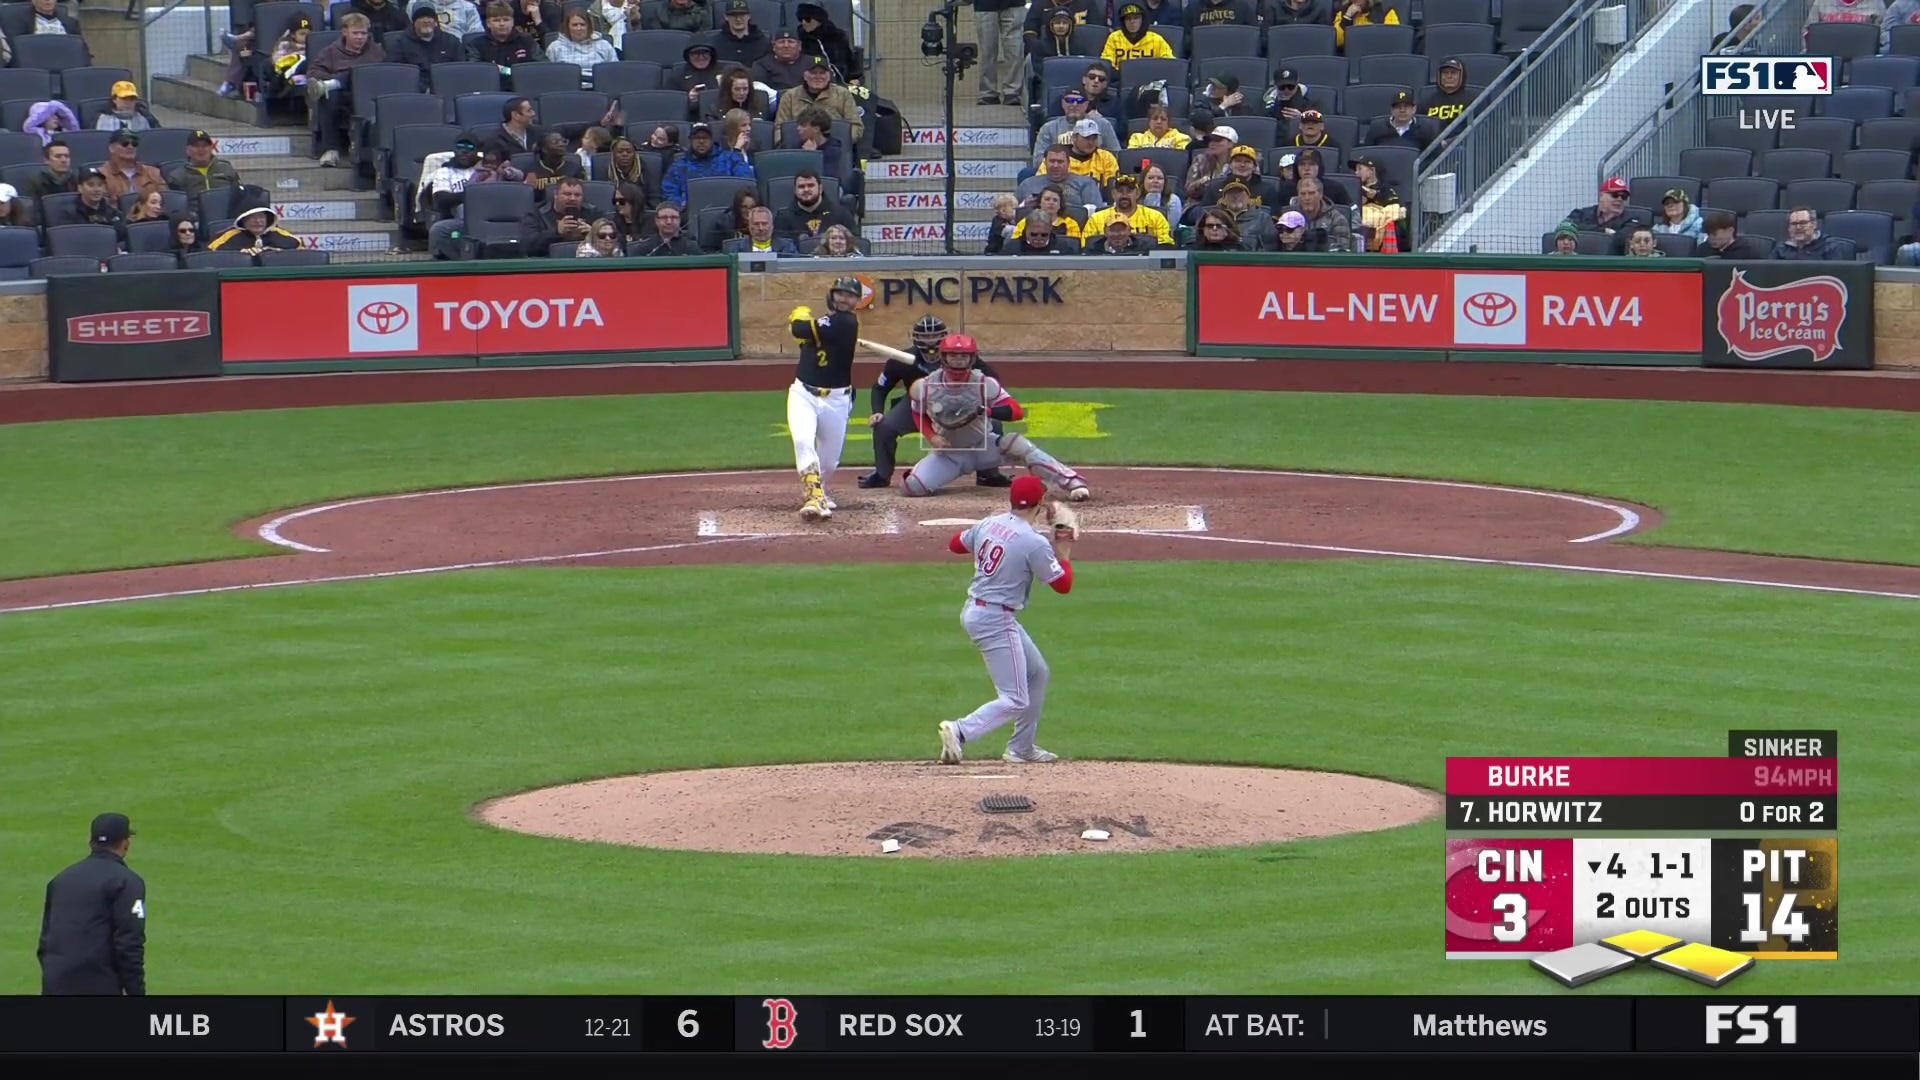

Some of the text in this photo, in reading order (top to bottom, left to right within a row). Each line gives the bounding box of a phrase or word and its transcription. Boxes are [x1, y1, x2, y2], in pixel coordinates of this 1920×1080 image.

[888, 163, 947, 177] RE/MA
[886, 194, 947, 208] RE/MA
[879, 276, 1065, 306] PNC PARK
[433, 297, 605, 331] TOYOTA
[1257, 291, 1439, 323] ALL-NEW
[1542, 295, 1643, 328] RAV4
[1735, 291, 1829, 333] Perry's
[77, 316, 201, 338] SHEETZ
[1750, 321, 1826, 342] Ice Cream
[816, 350, 829, 367] 2
[977, 537, 1005, 577] 49
[131, 899, 145, 919] 4
